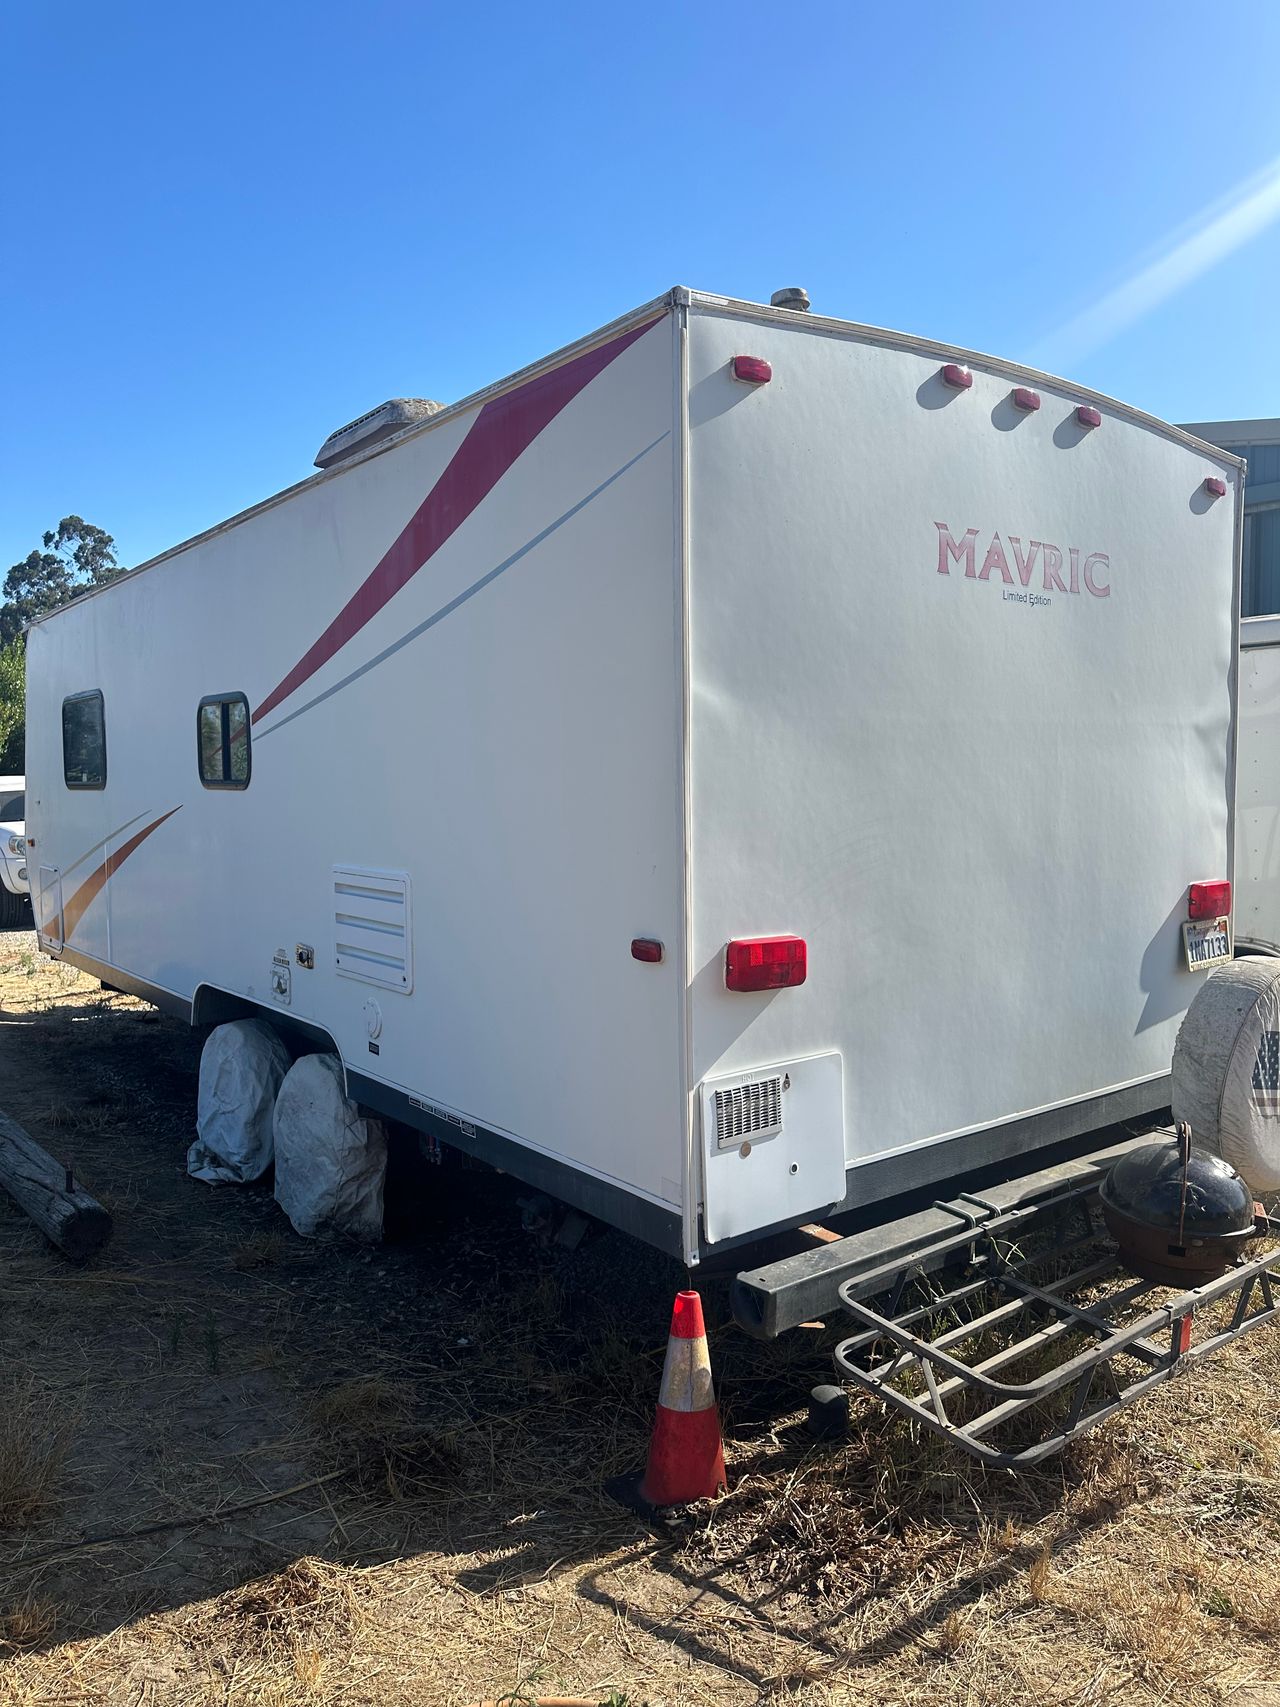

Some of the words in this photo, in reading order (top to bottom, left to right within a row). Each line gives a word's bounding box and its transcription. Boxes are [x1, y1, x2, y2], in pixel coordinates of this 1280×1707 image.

[934, 521, 1110, 598] MAVRIC
[1002, 589, 1028, 603] Limited
[1029, 593, 1052, 607] Edition
[742, 1073, 756, 1083] HOT
